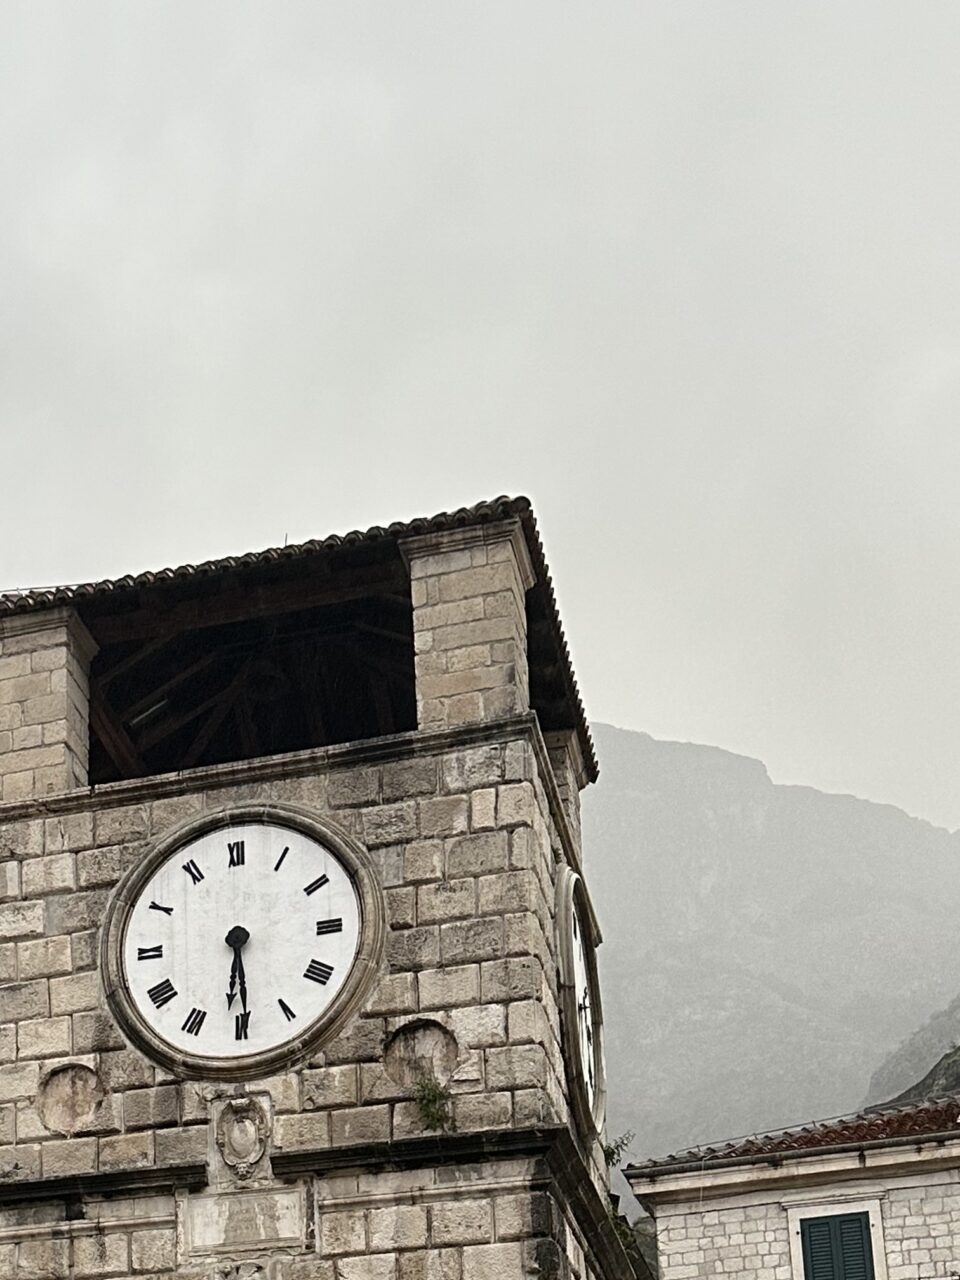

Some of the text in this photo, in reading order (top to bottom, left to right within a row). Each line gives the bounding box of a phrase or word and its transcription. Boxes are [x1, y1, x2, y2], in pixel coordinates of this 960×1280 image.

[227, 840, 245, 869] XII
[181, 859, 205, 886] XI
[303, 873, 330, 897] II
[148, 900, 174, 916] X
[316, 917, 343, 936] III
[137, 944, 163, 961] IX
[303, 958, 335, 986] IIII
[146, 978, 179, 1010] VIII
[181, 1007, 208, 1037] VII
[277, 998, 297, 1022] V
